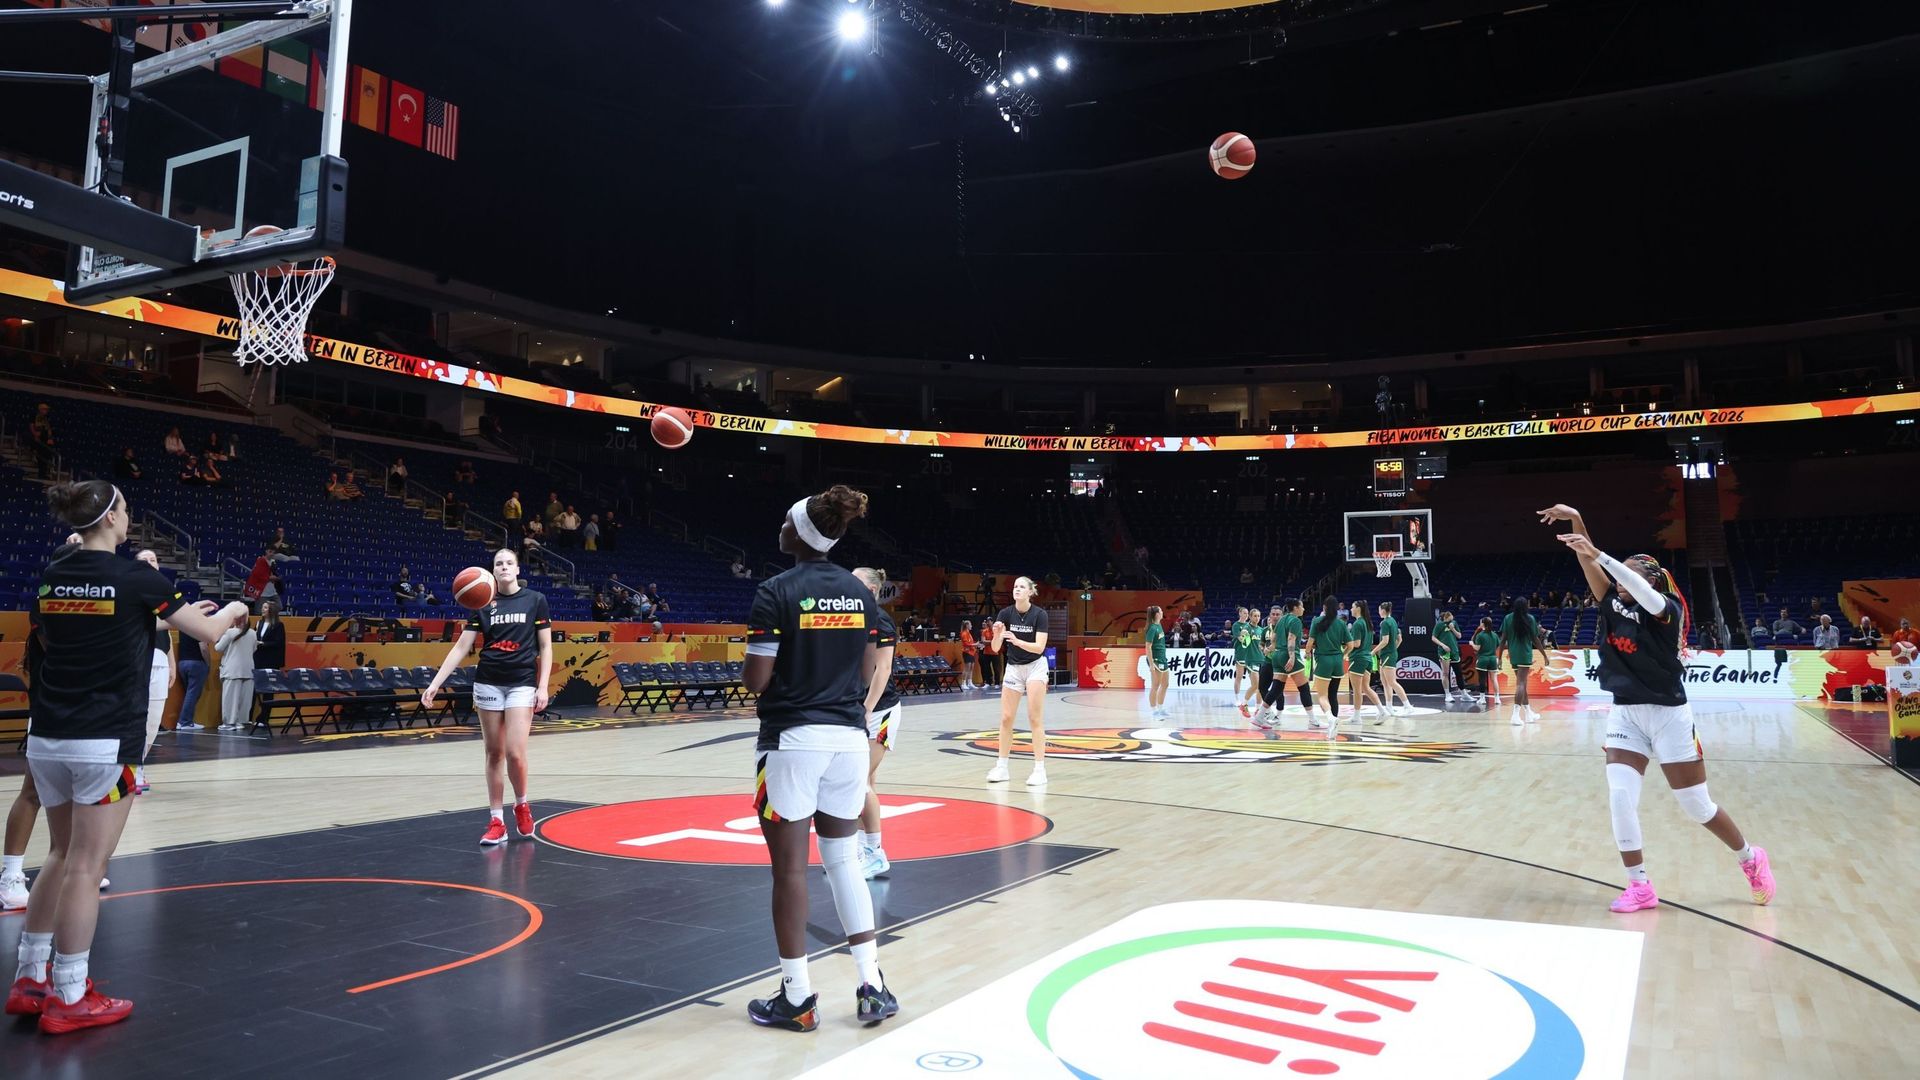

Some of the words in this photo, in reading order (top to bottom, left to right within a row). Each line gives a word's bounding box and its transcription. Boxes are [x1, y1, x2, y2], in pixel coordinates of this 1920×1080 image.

[340, 344, 356, 362] IN
[363, 349, 417, 374] BERLIN
[703, 412, 716, 426] TO
[720, 415, 767, 432] BERLIN
[1368, 431, 1396, 444] FIBA
[1399, 427, 1460, 442] WOMEN'S
[1464, 421, 1545, 438] BASKETBALL
[1549, 418, 1596, 433] WORLD
[1600, 416, 1631, 430] CUP
[1634, 411, 1704, 427] GERMANY
[1709, 410, 1745, 423] 2026
[984, 435, 1069, 449] WILLKOMMEN
[1072, 438, 1087, 450] IN
[1090, 437, 1136, 450] BERLIN
[1376, 462, 1402, 472] 46:58
[54, 584, 115, 598] crelan
[46, 601, 98, 612] DHL
[818, 595, 864, 610] crelan
[490, 613, 527, 626] BELGIUM
[812, 615, 854, 626] DHL
[1409, 626, 1427, 634] FIBA
